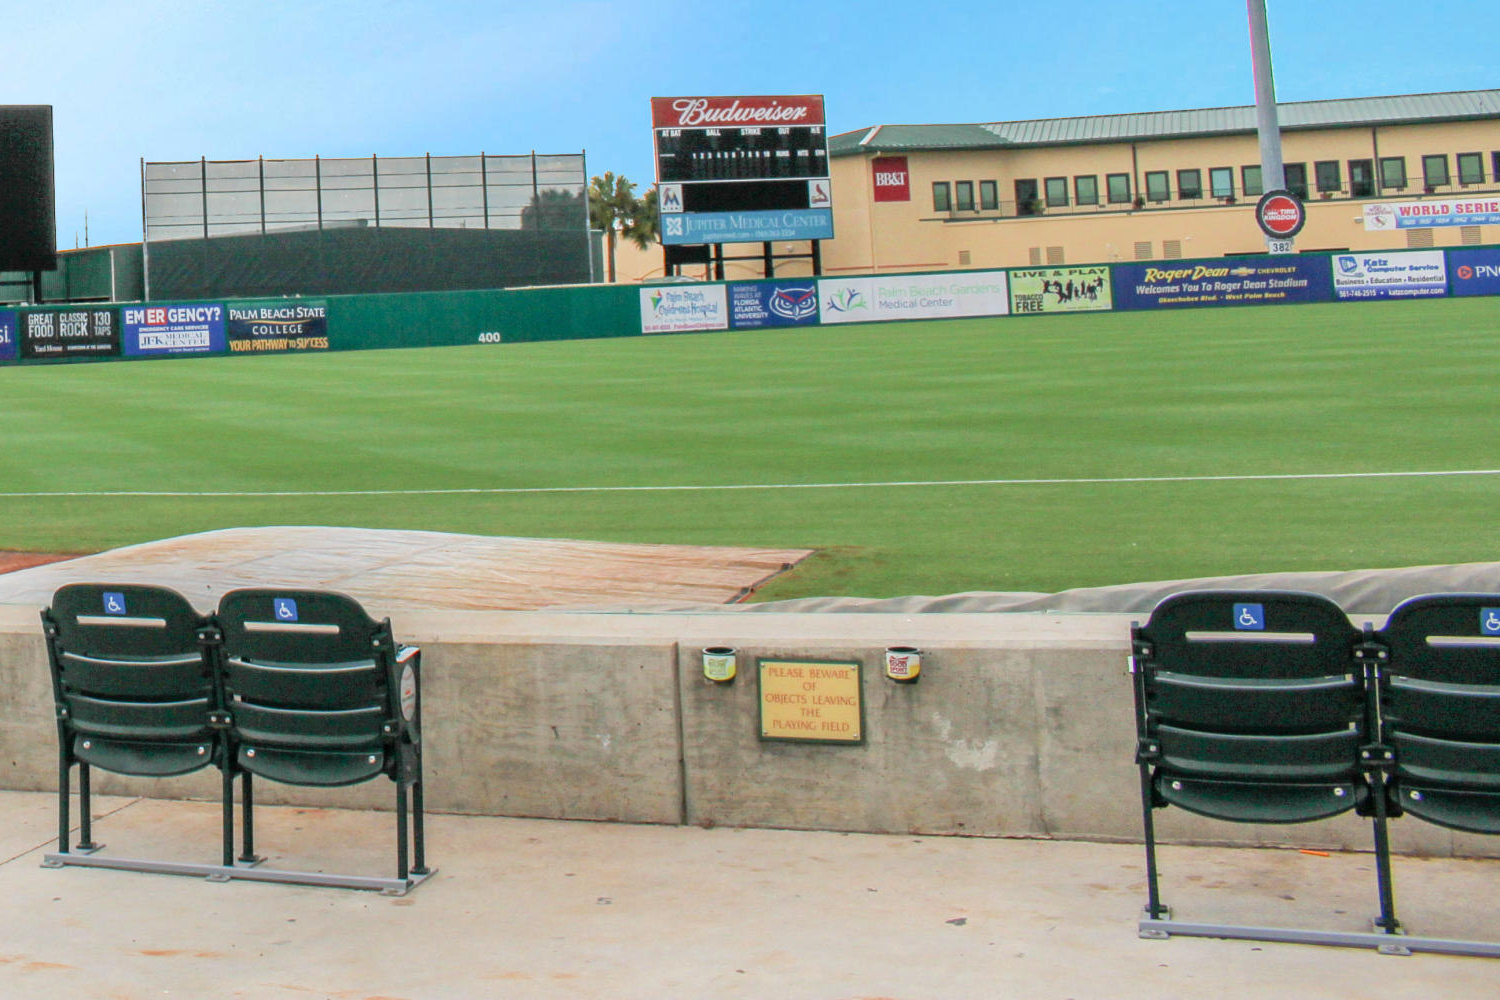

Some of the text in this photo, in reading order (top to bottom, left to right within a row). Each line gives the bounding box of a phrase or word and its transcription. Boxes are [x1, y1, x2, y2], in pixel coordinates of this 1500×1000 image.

[673, 99, 806, 125] Budweiser
[875, 171, 907, 186] BB&T
[1399, 204, 1450, 216] WORLD
[1455, 202, 1499, 214] SERIE
[685, 217, 726, 235] JUPITER
[729, 215, 779, 229] MEDICAL
[783, 213, 827, 227] CENTER
[1363, 259, 1389, 268] Katz
[1367, 265, 1407, 273] Computer
[1013, 271, 1046, 279] LIVE
[1069, 268, 1107, 276] PLAY
[1144, 266, 1296, 283] Roger Dean CHEVROLET
[1336, 274, 1445, 286] Business Education Residential
[879, 282, 1000, 297] Palm Beach Gardens
[1136, 278, 1308, 295] Welcomes You To Roger Dean Stadium
[734, 305, 763, 313] ATLANTIC
[879, 297, 953, 309] Medical Center
[1015, 301, 1044, 312] FREE
[28, 313, 53, 325] GREAT
[59, 312, 88, 323] CLASSIC
[95, 312, 110, 325] 130
[230, 307, 325, 320] PALM BEACH STATE
[28, 325, 53, 338] FOOD
[60, 322, 88, 336] ROCK
[94, 326, 111, 336] TAPS
[252, 325, 303, 335] COLLEGE
[141, 335, 164, 347] JFK
[478, 331, 500, 343] 400
[229, 340, 251, 351] YOUR
[252, 339, 288, 351] PATHWAY
[768, 667, 851, 680] PLEASE BEWARE
[803, 682, 817, 692] OF
[765, 693, 857, 706] OBJECTS LEAVING
[801, 708, 821, 718] THE
[772, 719, 850, 732] PLAYING FIELD
